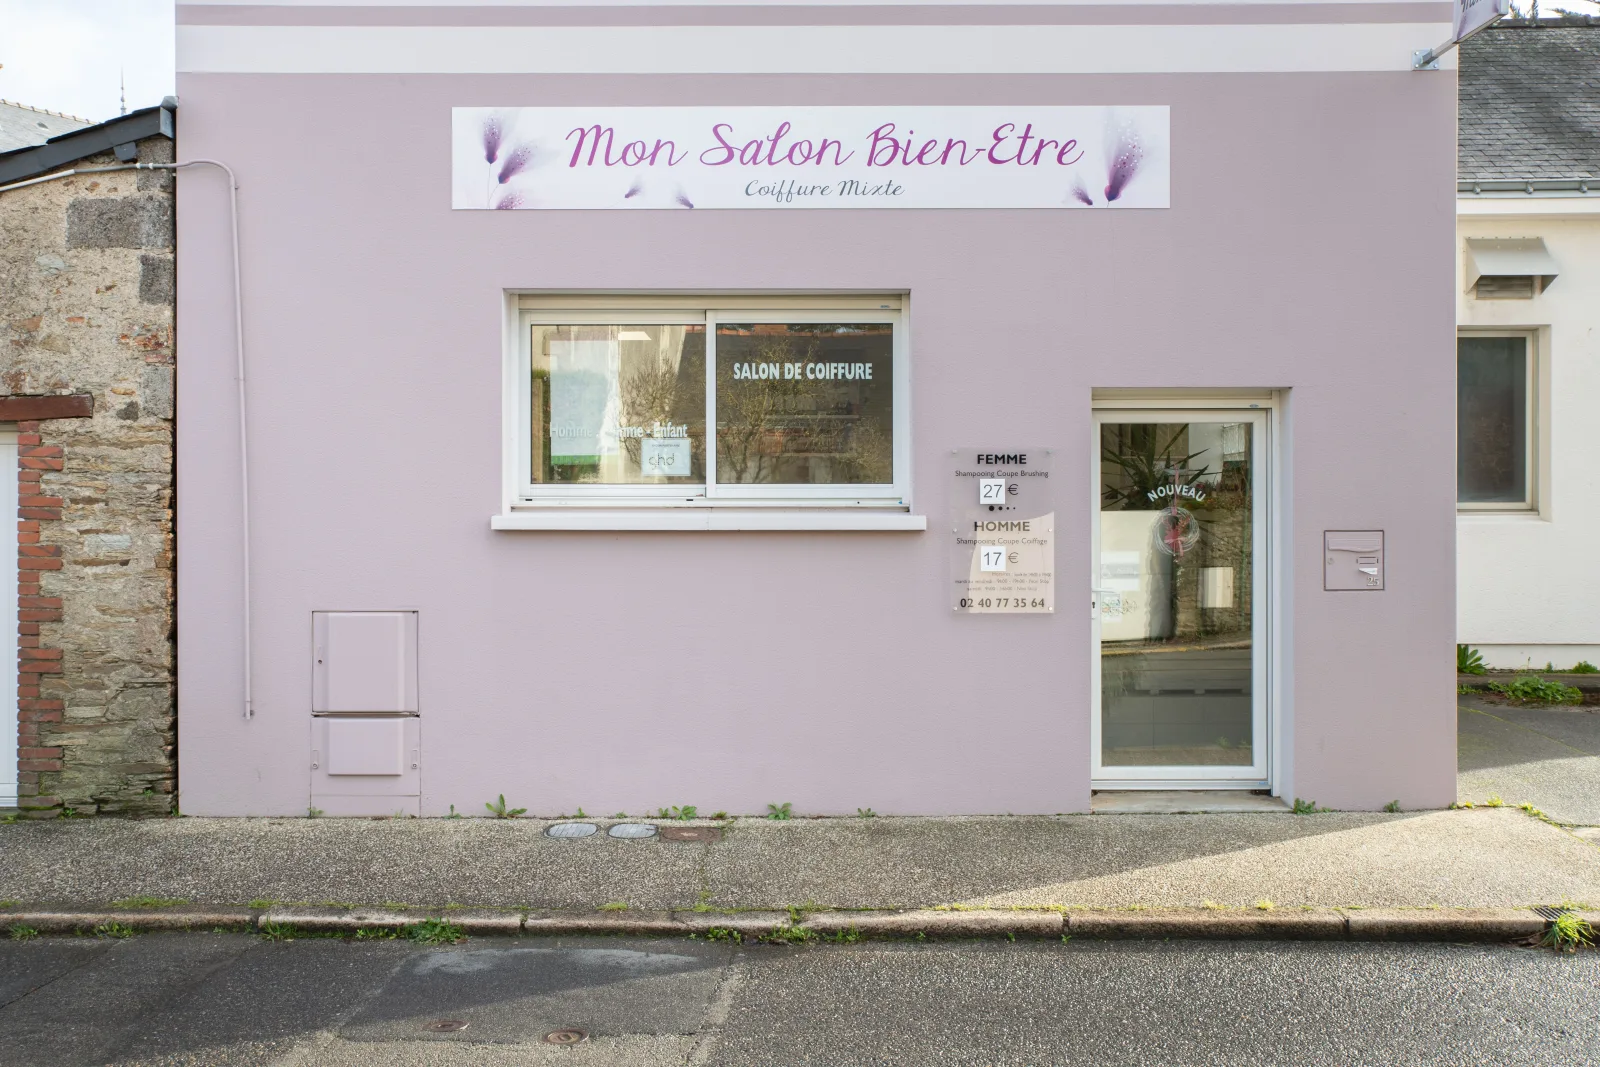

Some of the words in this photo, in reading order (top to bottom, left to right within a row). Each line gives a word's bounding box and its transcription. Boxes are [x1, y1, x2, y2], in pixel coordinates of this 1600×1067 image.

[565, 124, 688, 168] Mon
[699, 121, 855, 166] Salon
[866, 122, 1085, 167] Bien-Etre
[744, 179, 833, 203] Coiffure
[837, 179, 905, 196] Mixte
[733, 362, 780, 380] SALON
[784, 362, 802, 380] DE
[806, 362, 873, 380] COIFFURE
[653, 421, 688, 438] Enfant
[977, 454, 1027, 465] FEMME
[955, 469, 995, 478] Shampooing
[996, 469, 1019, 478] Coupe
[1020, 469, 1049, 478] Brushing
[983, 484, 1003, 498] 27
[1007, 483, 1019, 496] €
[1147, 484, 1206, 502] NOUVEAU
[973, 521, 1030, 532] HOMME
[956, 537, 996, 546] Shampooing
[997, 537, 1020, 546] Coupe
[1021, 537, 1048, 546] Coiffage
[983, 551, 1002, 566] 17
[1007, 551, 1019, 564] €
[960, 598, 974, 608] 02
[978, 598, 992, 608] 40
[996, 598, 1009, 608] 77
[1013, 598, 1027, 608] 35
[1031, 598, 1045, 608] 64
